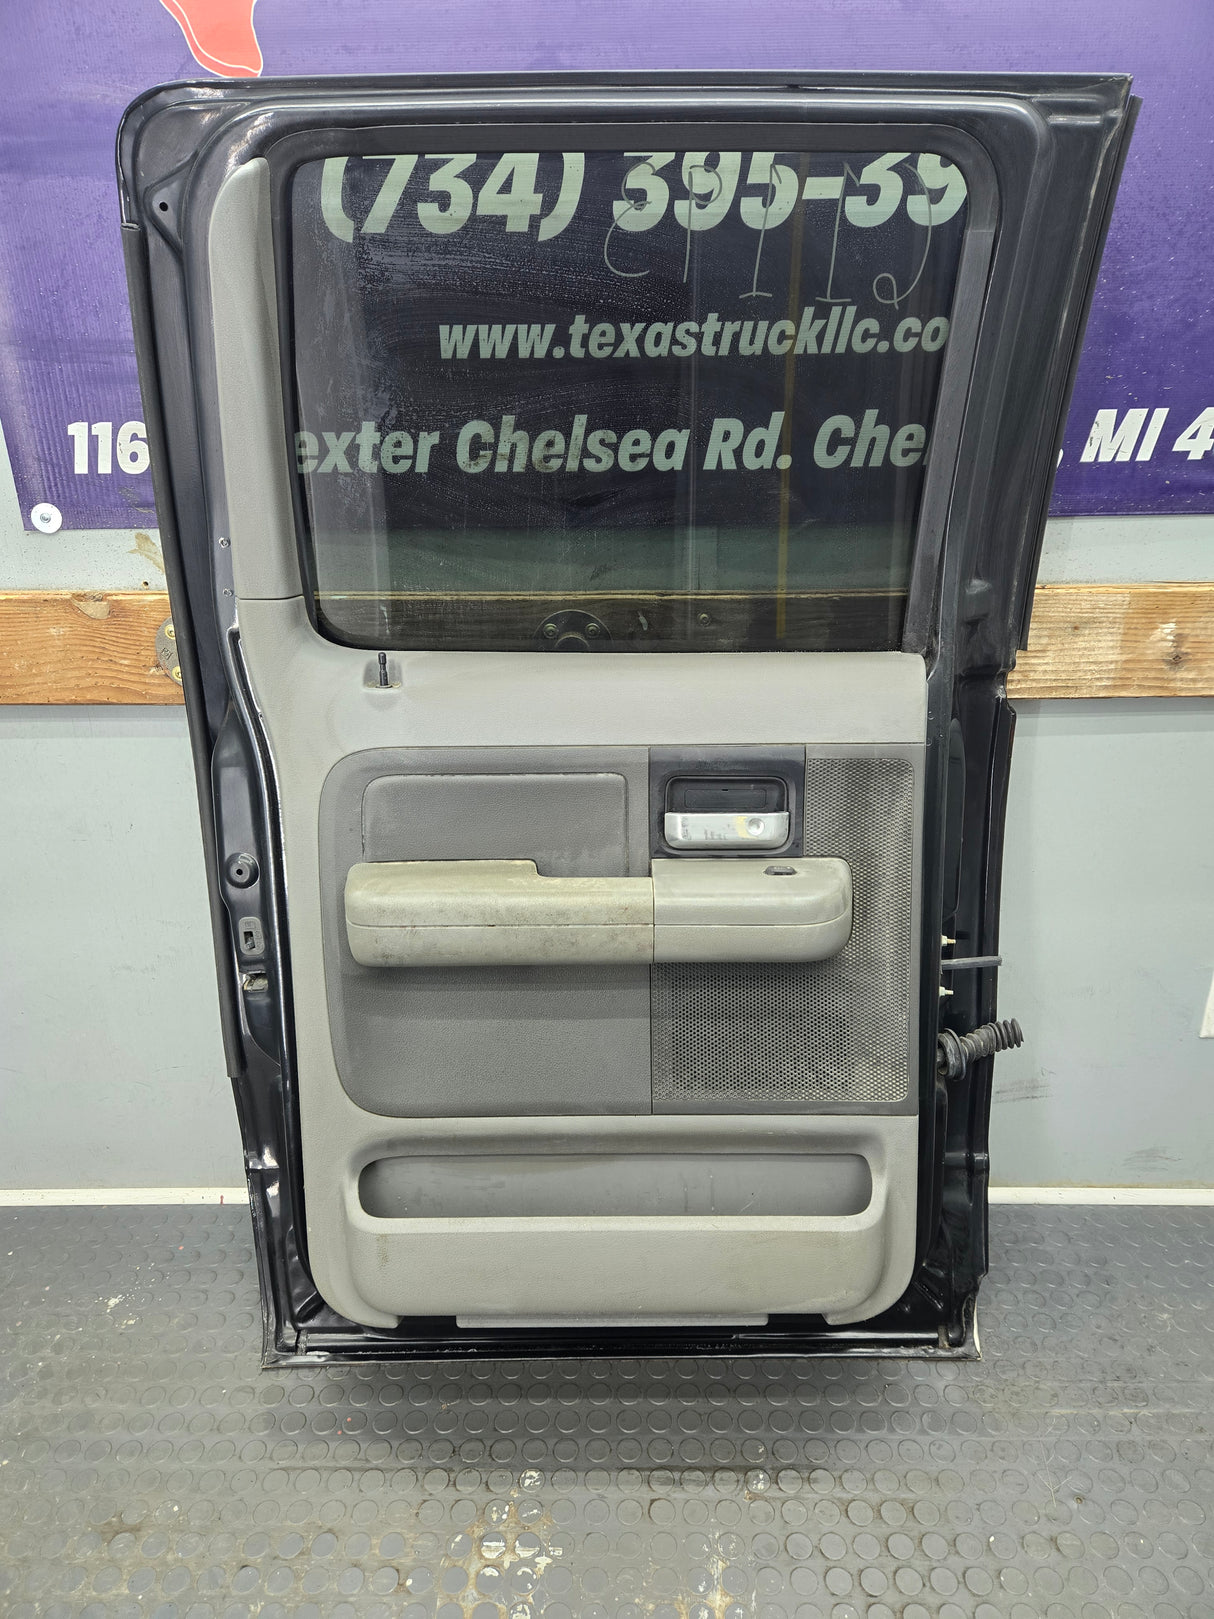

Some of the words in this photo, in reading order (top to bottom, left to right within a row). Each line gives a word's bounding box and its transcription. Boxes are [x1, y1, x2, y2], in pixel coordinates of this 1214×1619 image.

[320, 152, 585, 243] (734)
[612, 151, 968, 232] 395-39
[438, 306, 950, 360] www.texastruckllc.co
[67, 420, 150, 475] 116
[294, 421, 440, 474] exter
[456, 414, 690, 473] Chelsea
[702, 411, 793, 471] Rd.
[813, 408, 930, 470] Che
[1079, 407, 1170, 463] MI
[1171, 406, 1214, 461] 4
